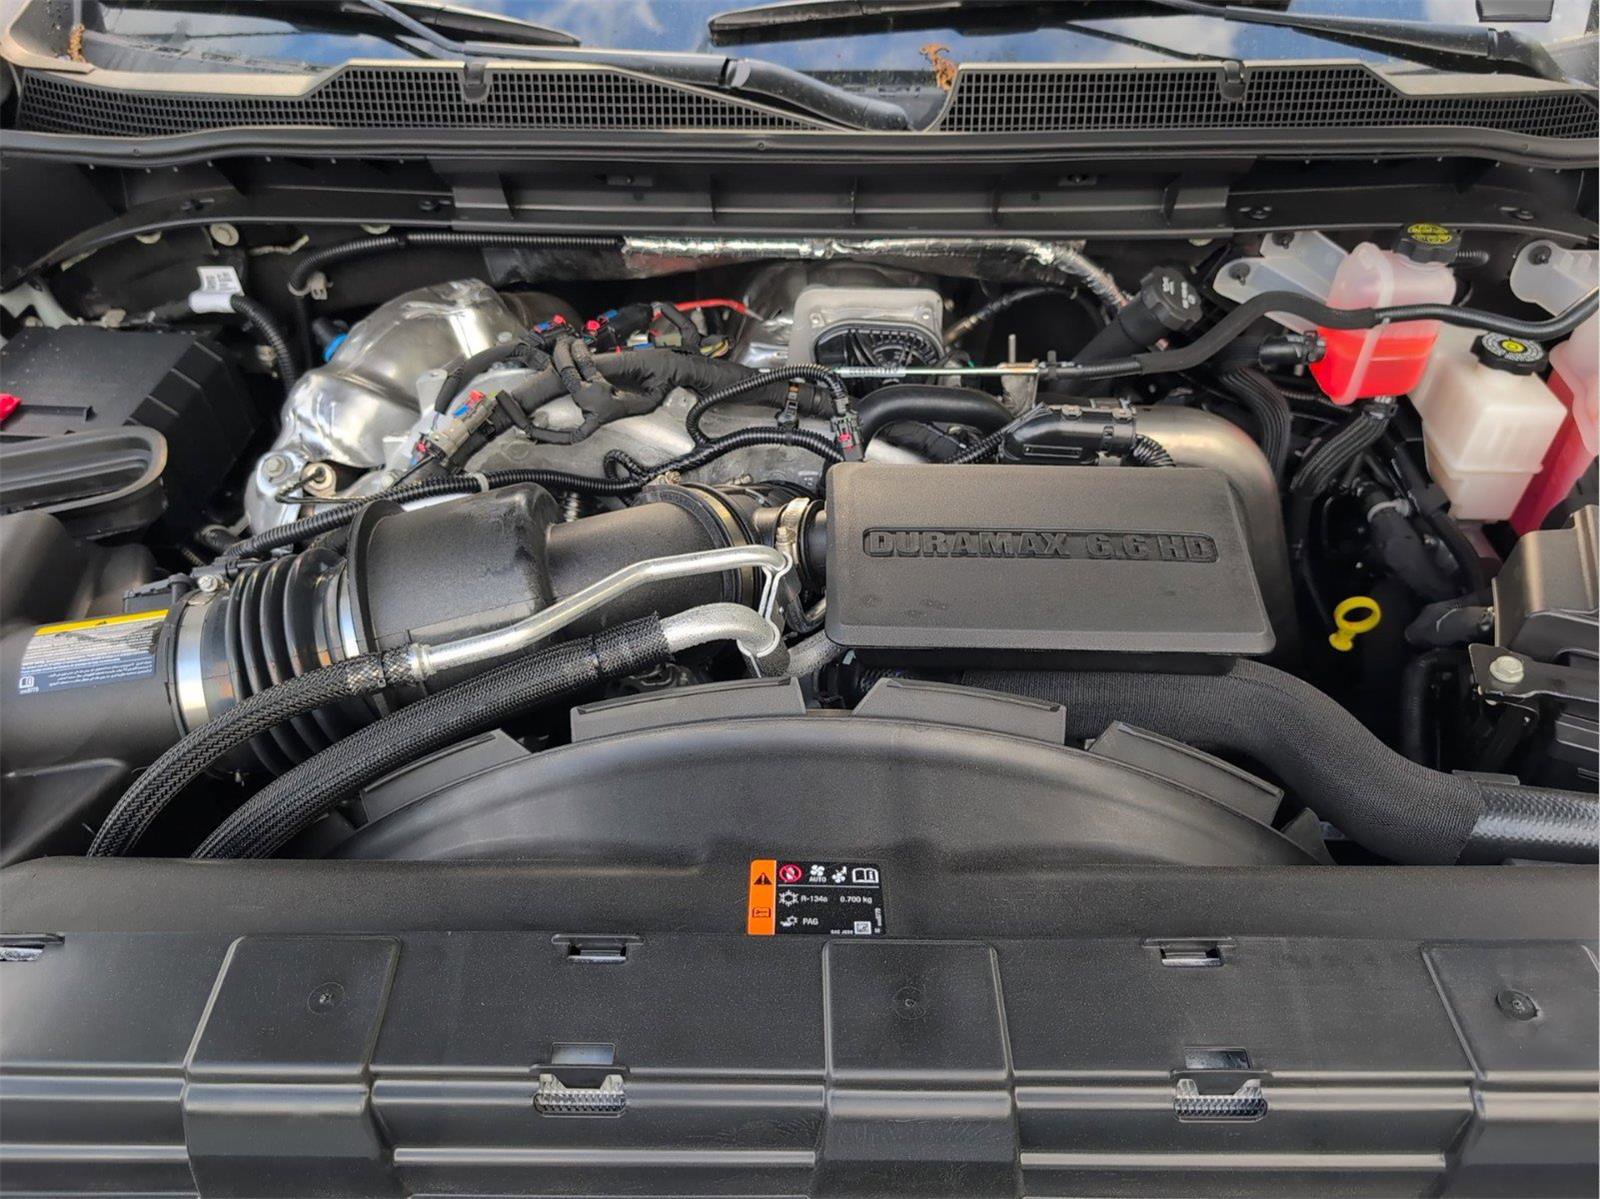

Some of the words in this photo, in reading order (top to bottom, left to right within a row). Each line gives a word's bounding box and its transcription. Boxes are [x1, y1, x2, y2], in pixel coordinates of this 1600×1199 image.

[868, 530, 1070, 557] DURAMAX
[1087, 533, 1151, 560] 6.6
[1158, 534, 1214, 562] HD
[840, 895, 861, 903] 0.700
[862, 896, 873, 904] kg
